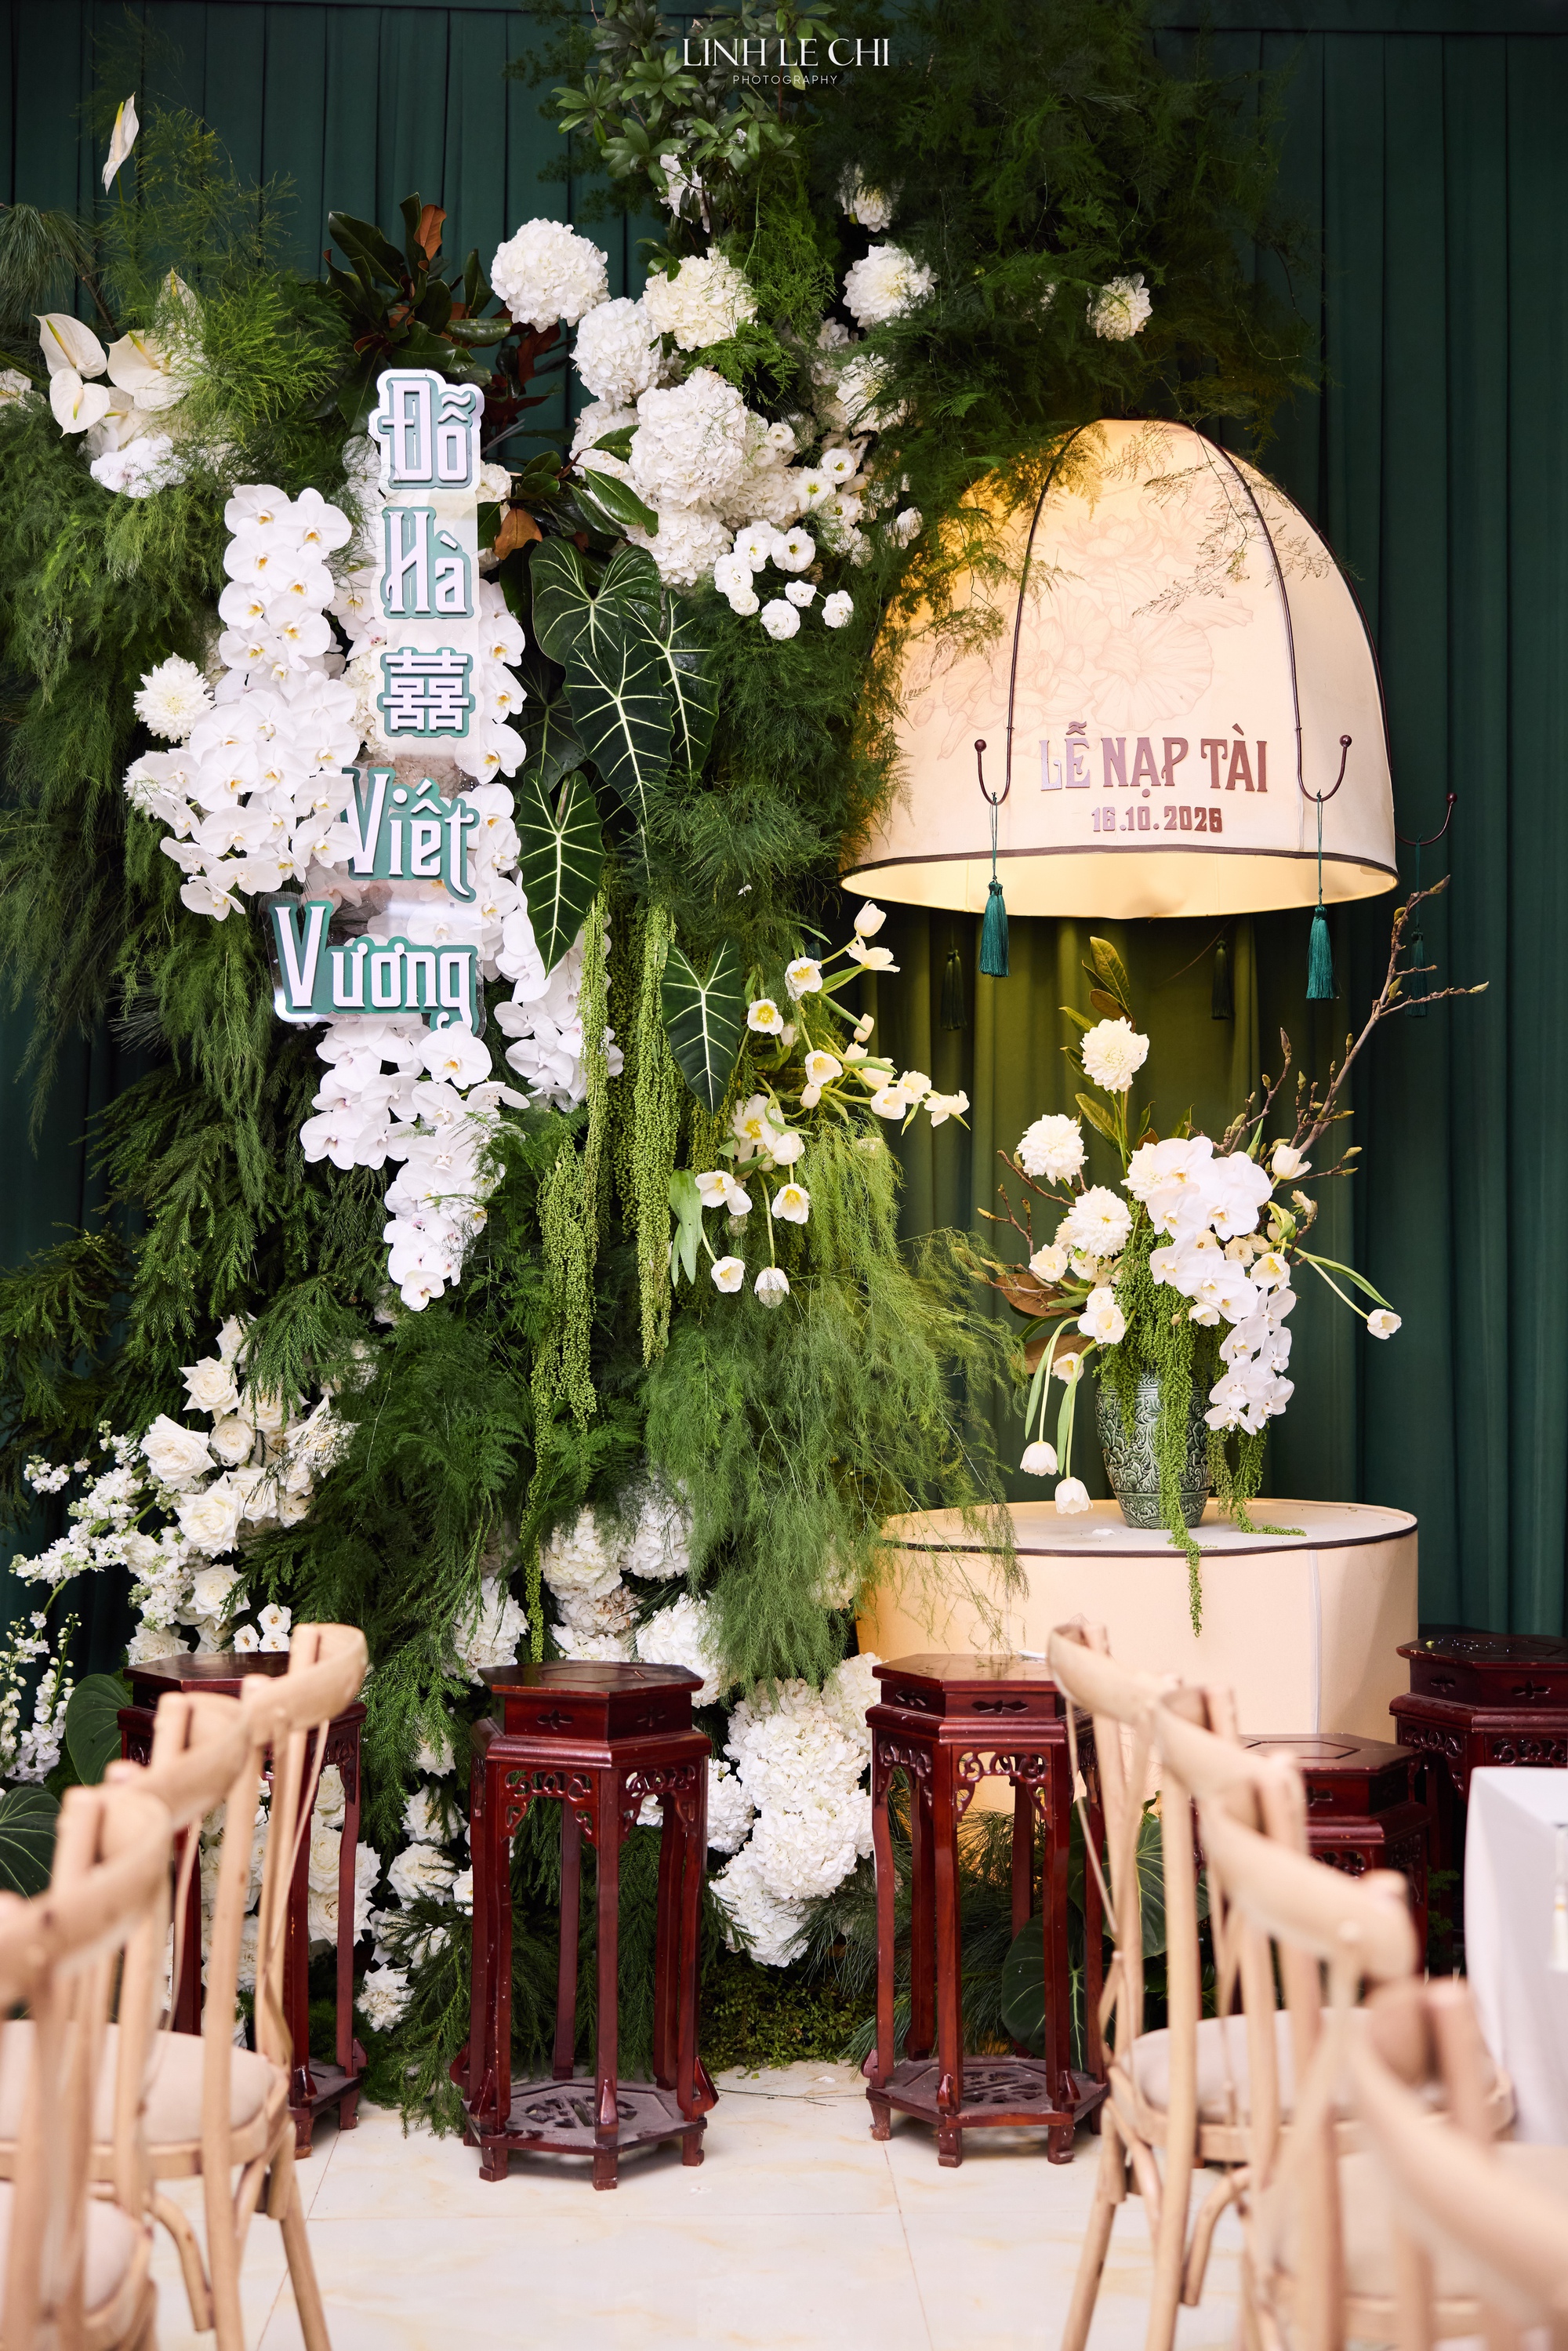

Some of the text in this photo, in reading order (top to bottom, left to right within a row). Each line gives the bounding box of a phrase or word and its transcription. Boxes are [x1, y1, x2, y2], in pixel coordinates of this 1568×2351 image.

[381, 380, 471, 481] Đỗ
[385, 511, 467, 614] Hà
[1039, 721, 1268, 798] LỄ NẠP TÀI
[342, 773, 475, 896] Viết
[274, 906, 472, 1030] Vương
